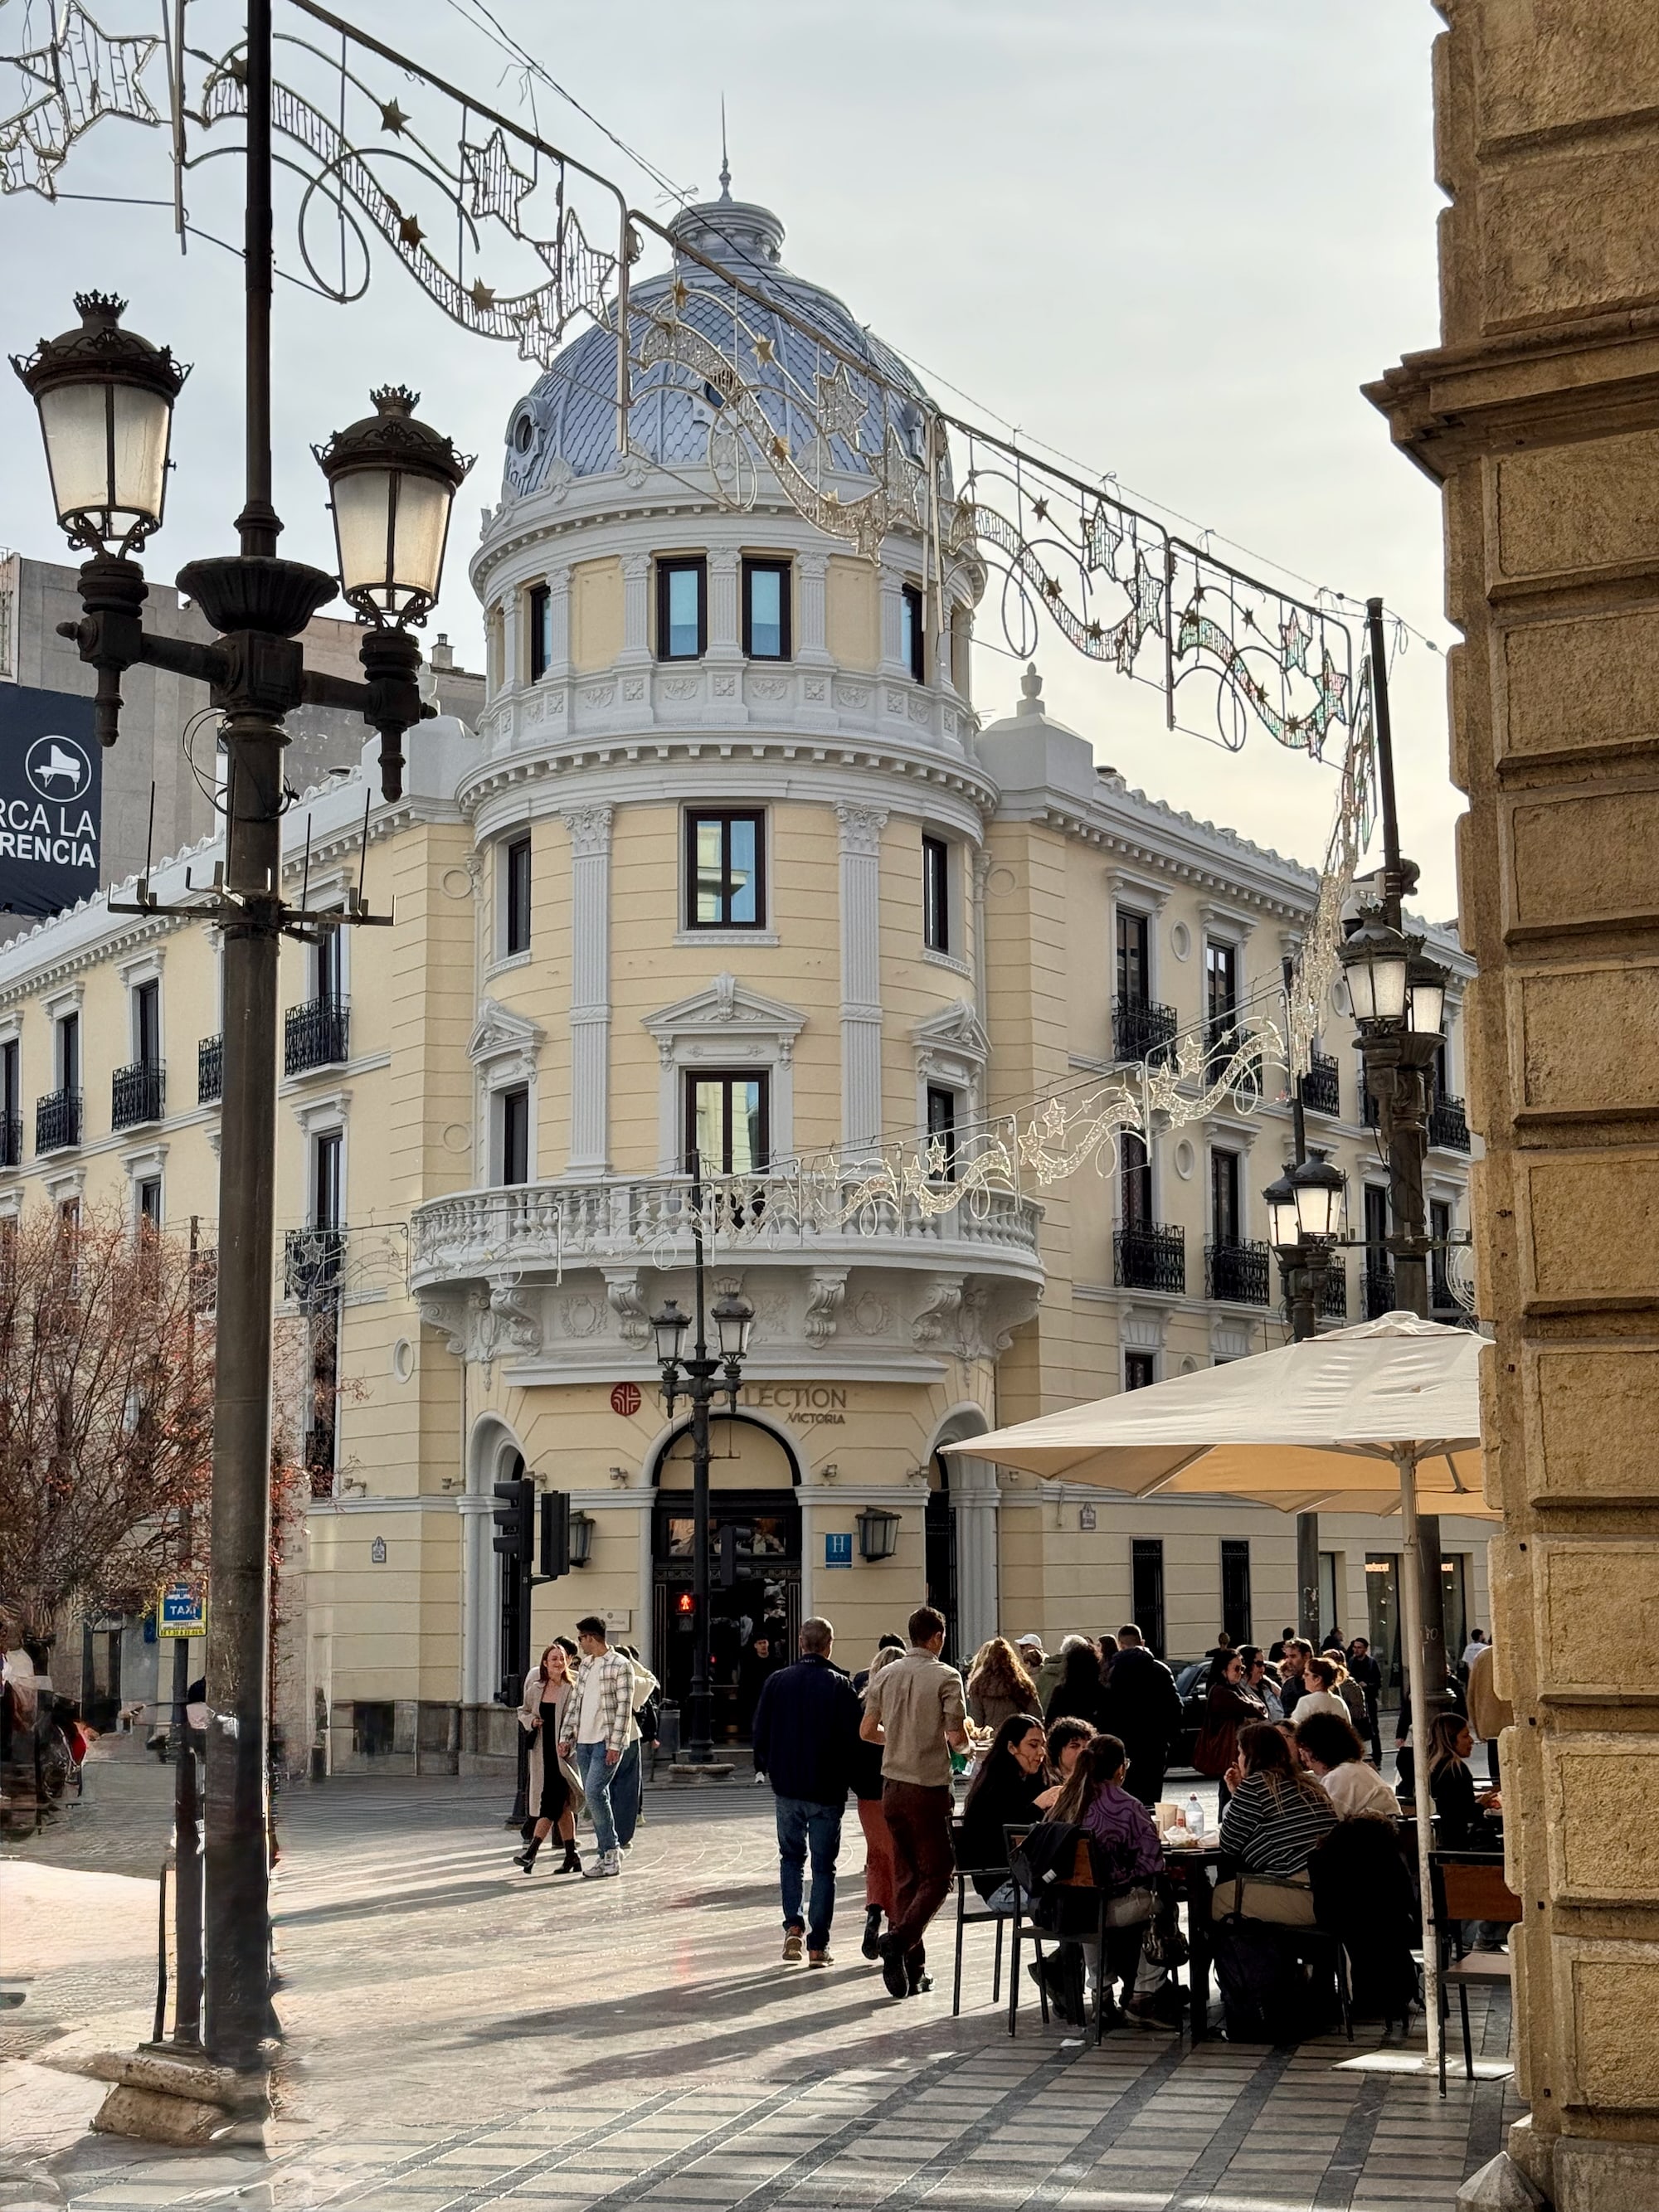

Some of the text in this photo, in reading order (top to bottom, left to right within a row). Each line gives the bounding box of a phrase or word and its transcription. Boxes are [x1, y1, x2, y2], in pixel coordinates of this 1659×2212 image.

[60, 807, 96, 840] LA
[0, 831, 96, 868] RENCIA
[787, 1412, 846, 1425] VICTORIA
[832, 1535, 844, 1553] H
[169, 1605, 197, 1615] TAXI
